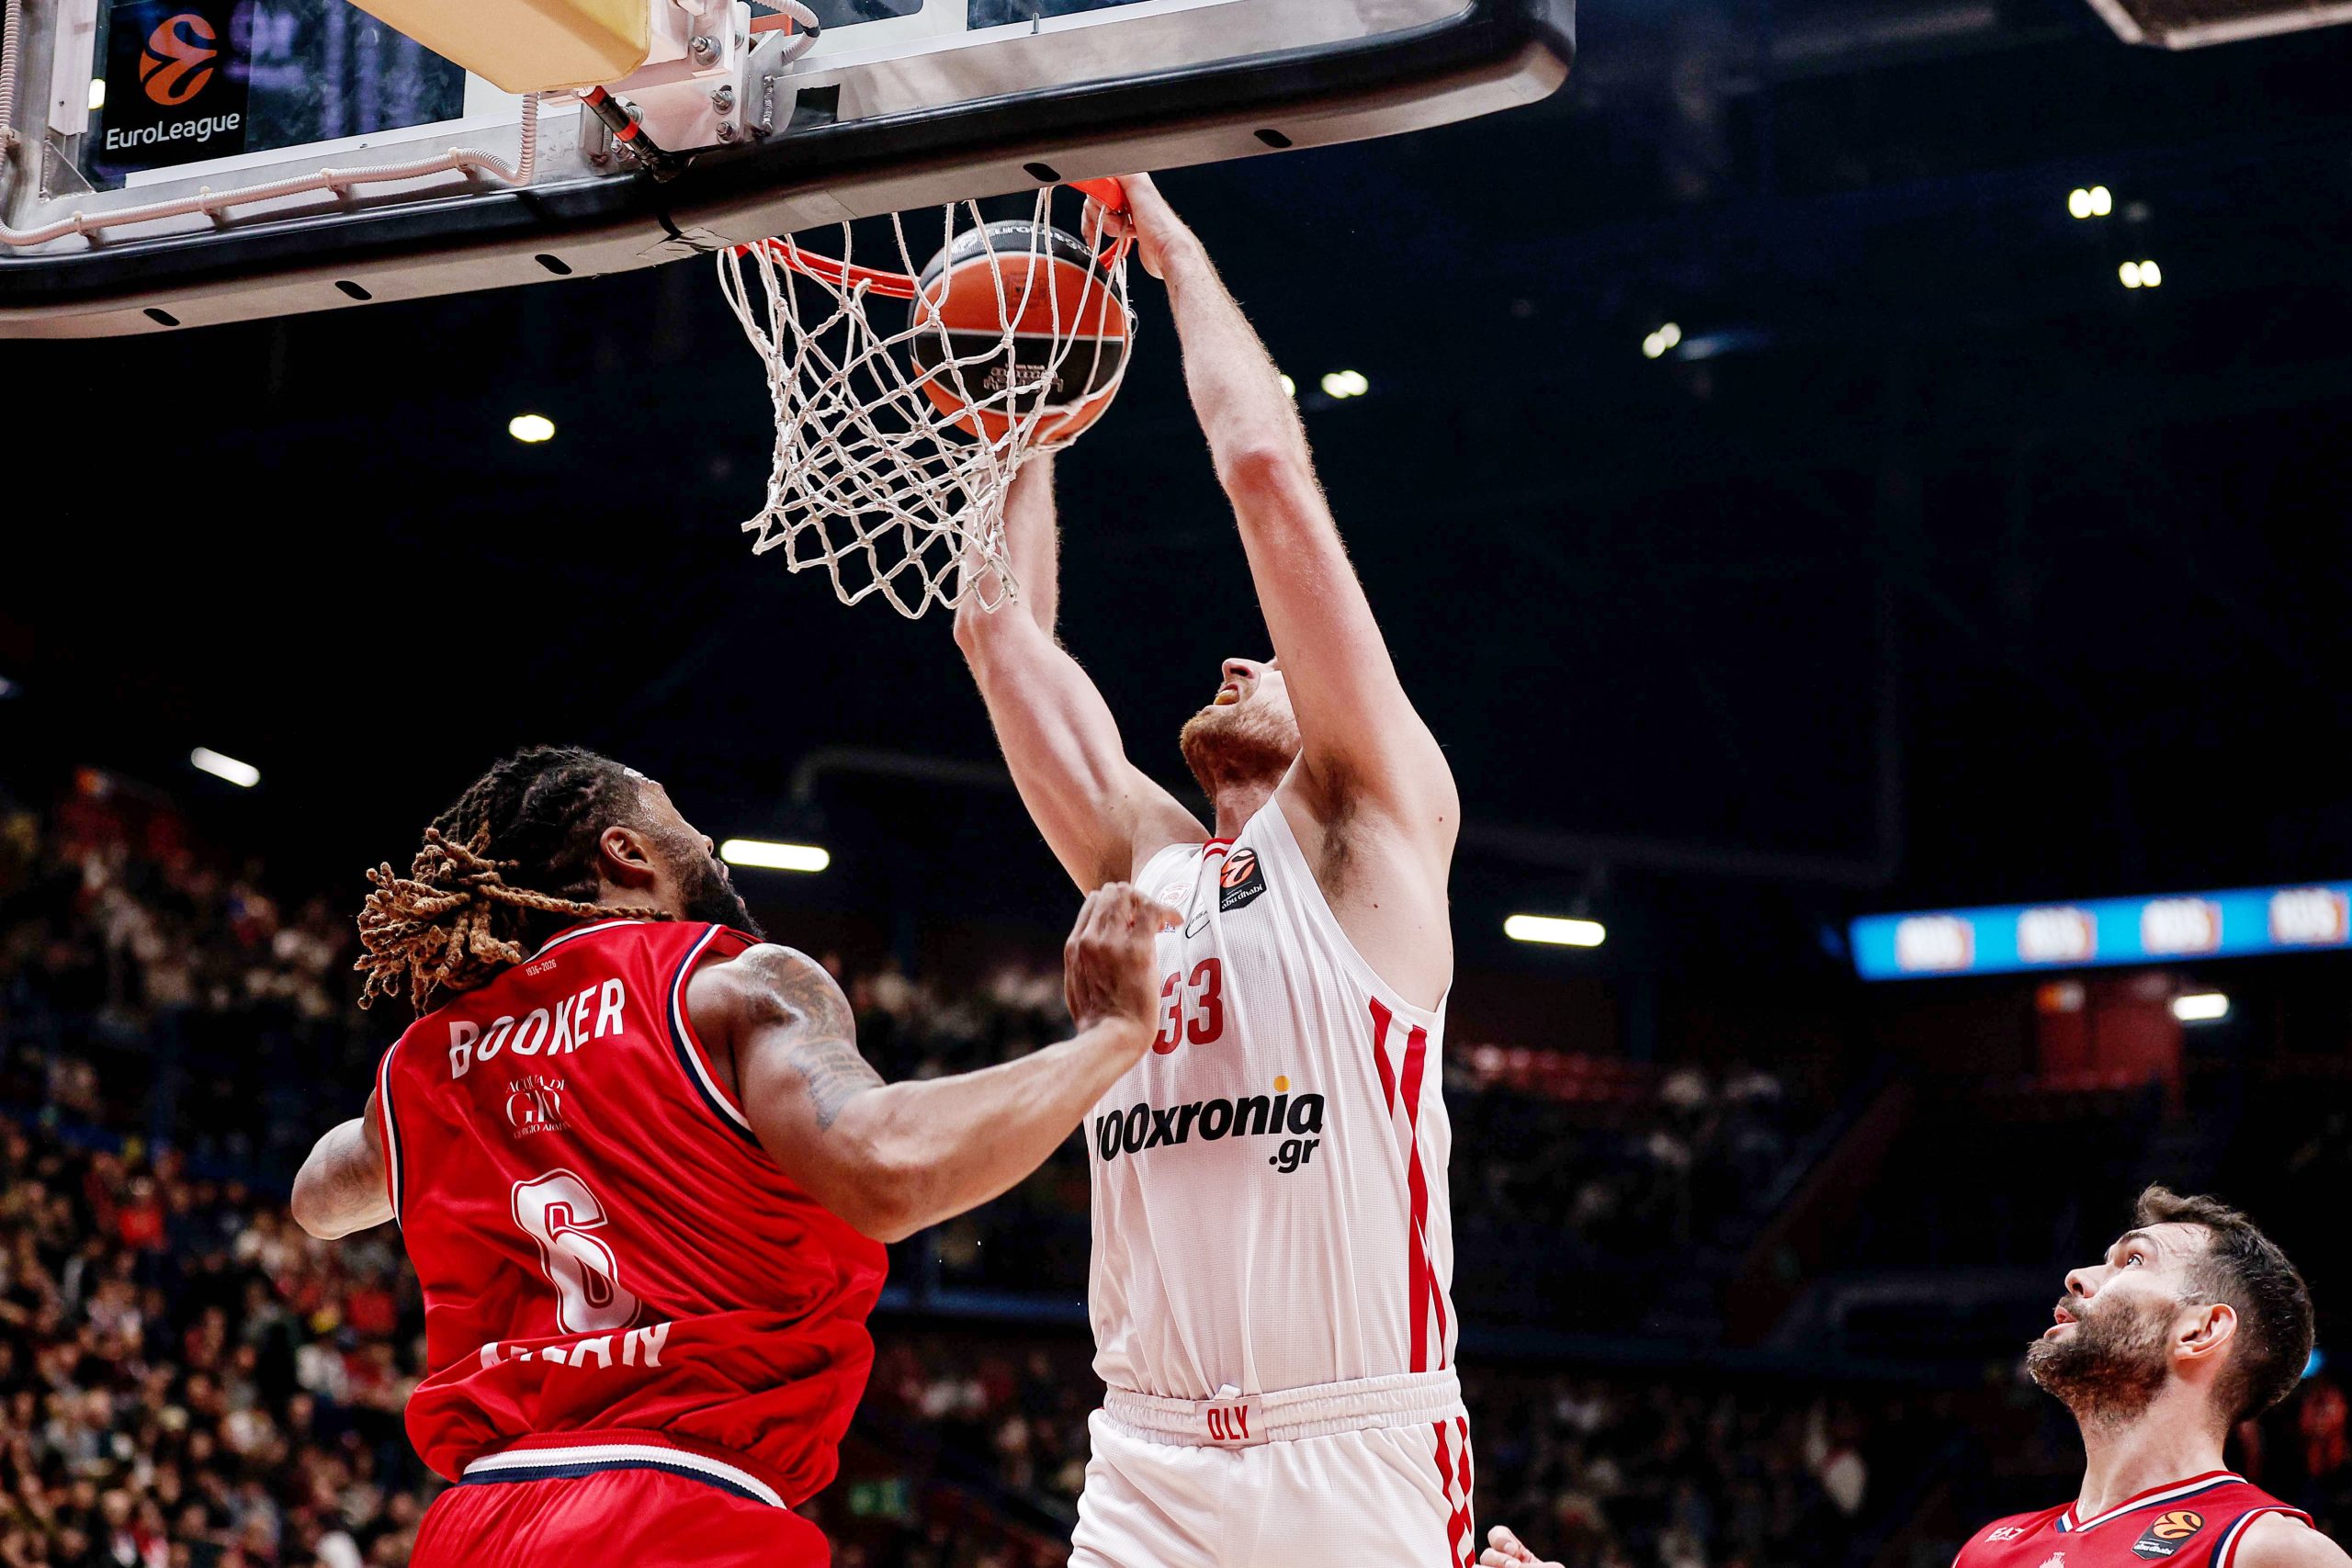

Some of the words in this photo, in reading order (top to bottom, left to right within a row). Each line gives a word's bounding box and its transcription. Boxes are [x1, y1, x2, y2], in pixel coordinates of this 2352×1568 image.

[106, 112, 240, 151] EuroLeague
[1238, 883, 1263, 900] dhabi
[526, 958, 558, 977] 1936-2026
[1152, 957, 1224, 1055] 33
[448, 977, 626, 1080] BOOKER
[549, 1078, 565, 1091] DI
[1269, 1138, 1320, 1174] .gr
[511, 1167, 642, 1336] 6
[1206, 1404, 1250, 1441] OLY
[1988, 1527, 2026, 1540] EA7
